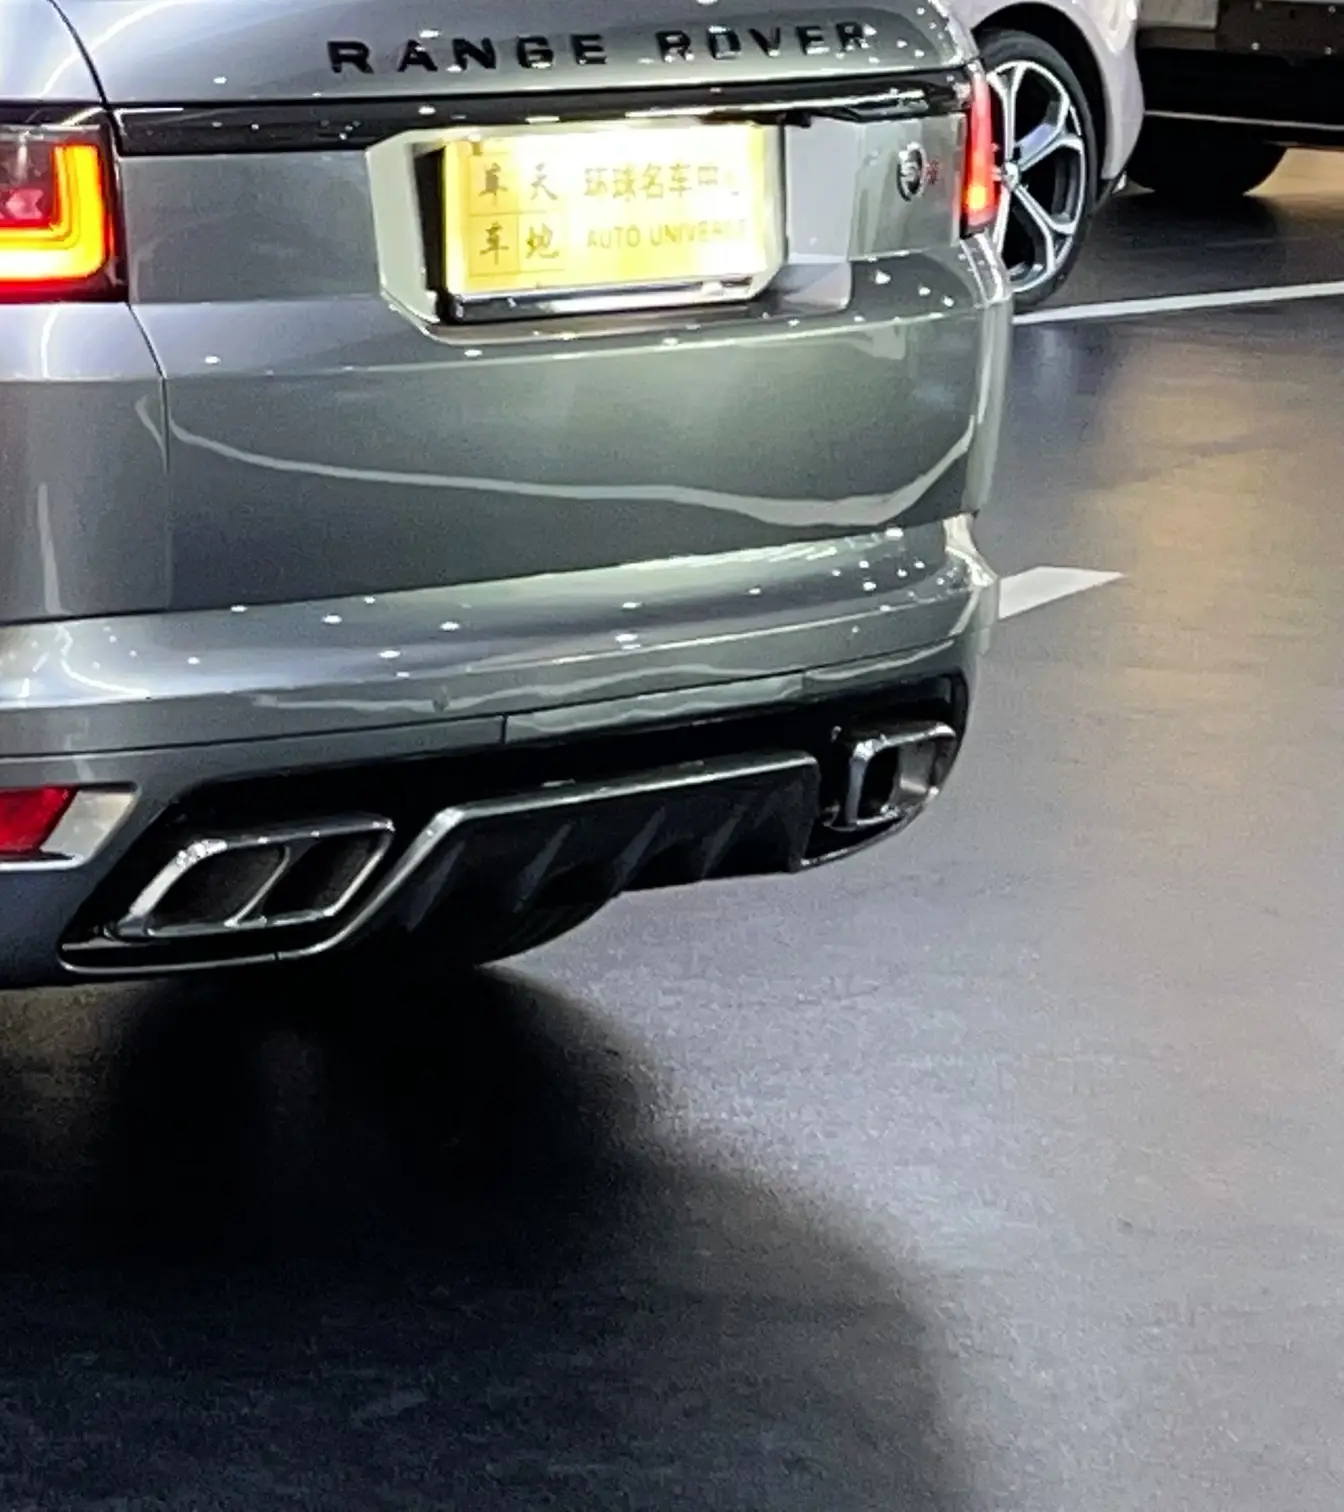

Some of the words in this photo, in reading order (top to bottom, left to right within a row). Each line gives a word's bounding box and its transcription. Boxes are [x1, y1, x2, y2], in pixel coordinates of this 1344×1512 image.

[326, 32, 609, 75] RANGE
[655, 20, 870, 62] ROVER
[584, 163, 742, 201] 环球名车中
[587, 223, 641, 249] AUTO
[650, 218, 746, 247] UNIVE
